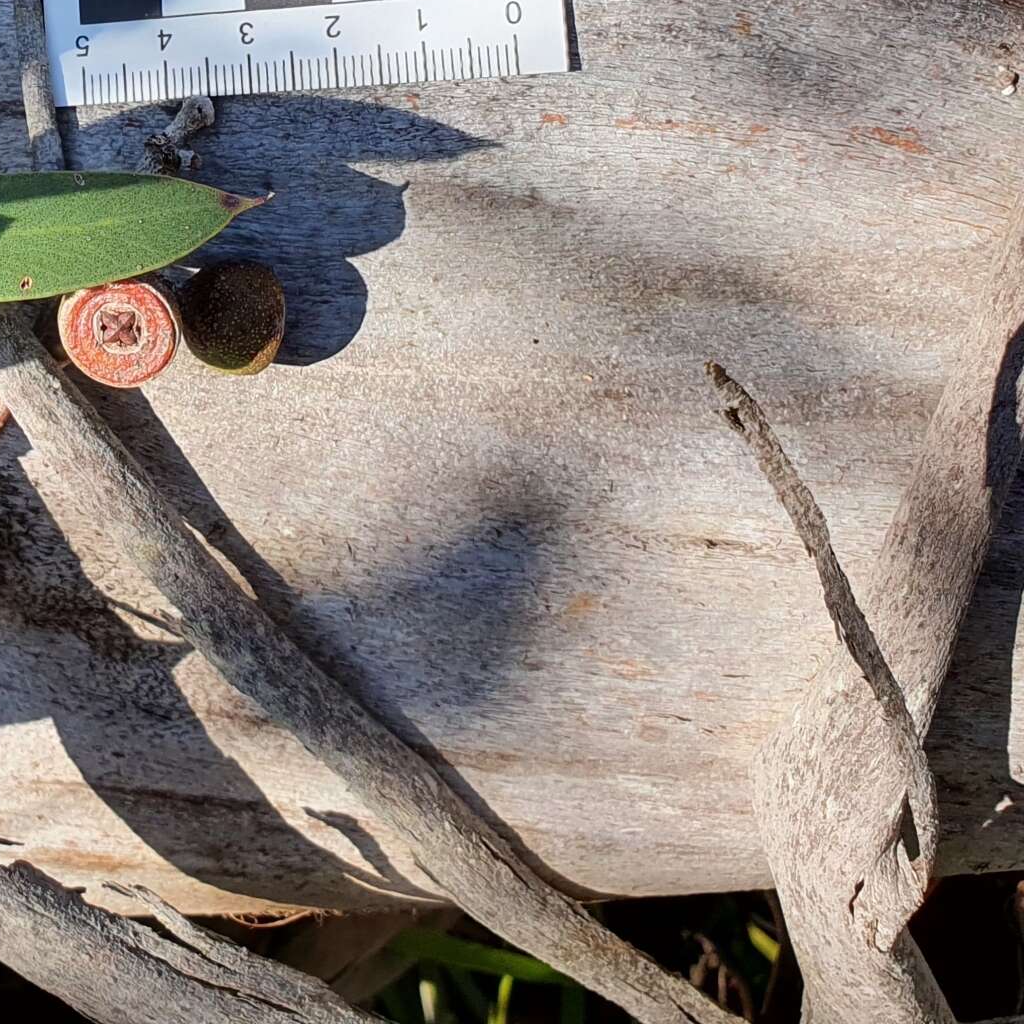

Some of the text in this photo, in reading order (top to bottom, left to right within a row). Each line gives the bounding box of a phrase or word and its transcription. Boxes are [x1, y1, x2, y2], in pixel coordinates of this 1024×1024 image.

[76, 1, 522, 56] 0 1 2 3 4 5
